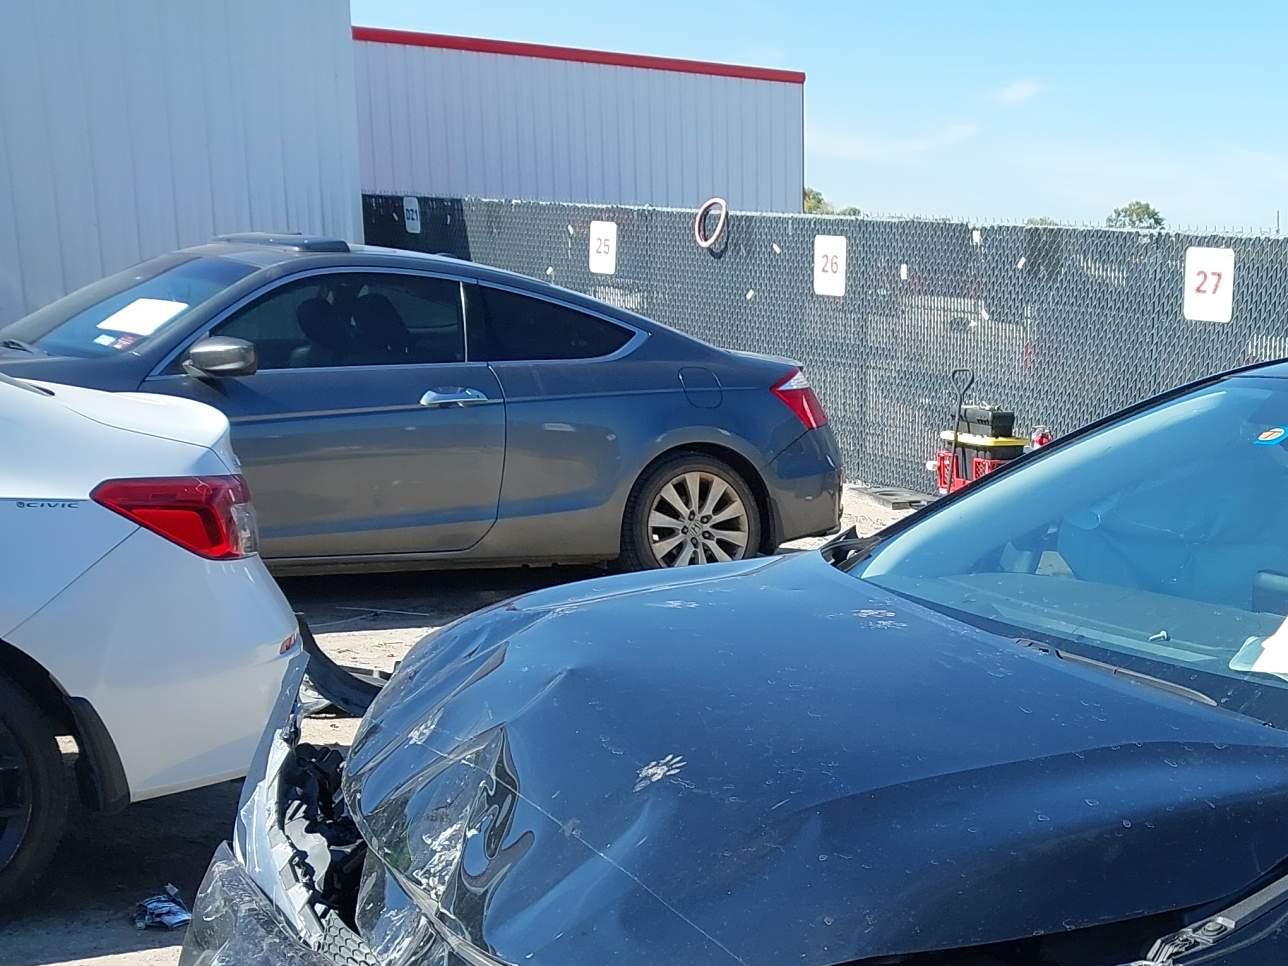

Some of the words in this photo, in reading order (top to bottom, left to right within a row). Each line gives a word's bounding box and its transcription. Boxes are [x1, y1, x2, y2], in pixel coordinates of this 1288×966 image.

[595, 238, 610, 255] 25
[821, 254, 839, 274] 26
[1194, 270, 1223, 295] 27
